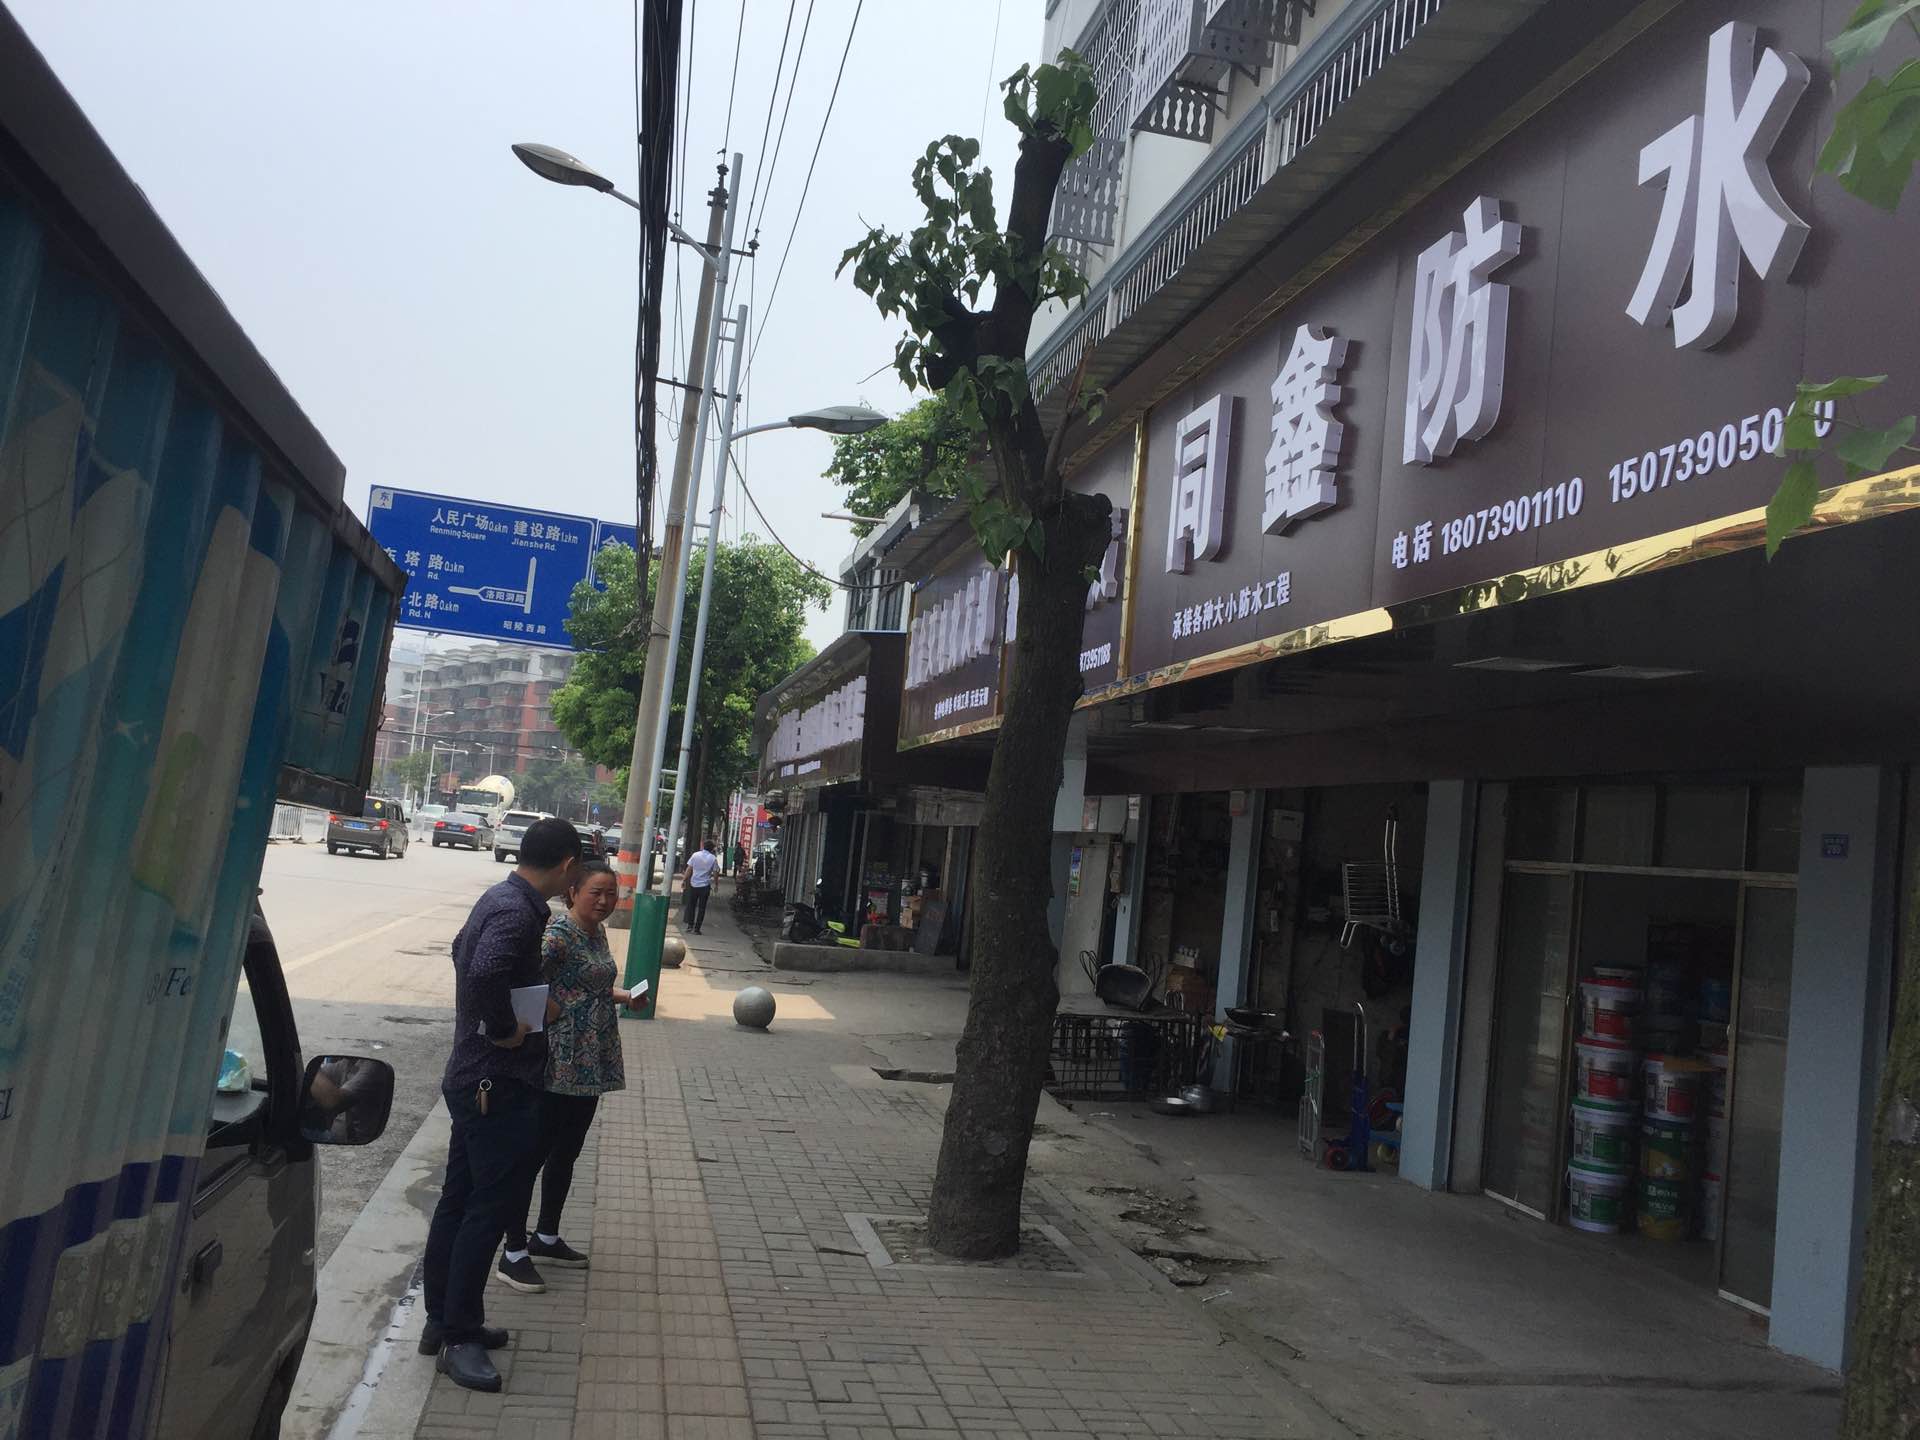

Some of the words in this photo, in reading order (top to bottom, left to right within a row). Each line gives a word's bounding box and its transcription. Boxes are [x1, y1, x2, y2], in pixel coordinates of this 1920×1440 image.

[1165, 20, 1811, 574] 同鑫防水
[1609, 400, 1835, 503] 1507390500
[431, 507, 490, 532] 人民广场
[513, 519, 561, 541] 建设路
[1392, 520, 1433, 569] 电话
[1441, 476, 1584, 556] 18073901110
[1172, 571, 1291, 641] 承接各种大小防水工程
